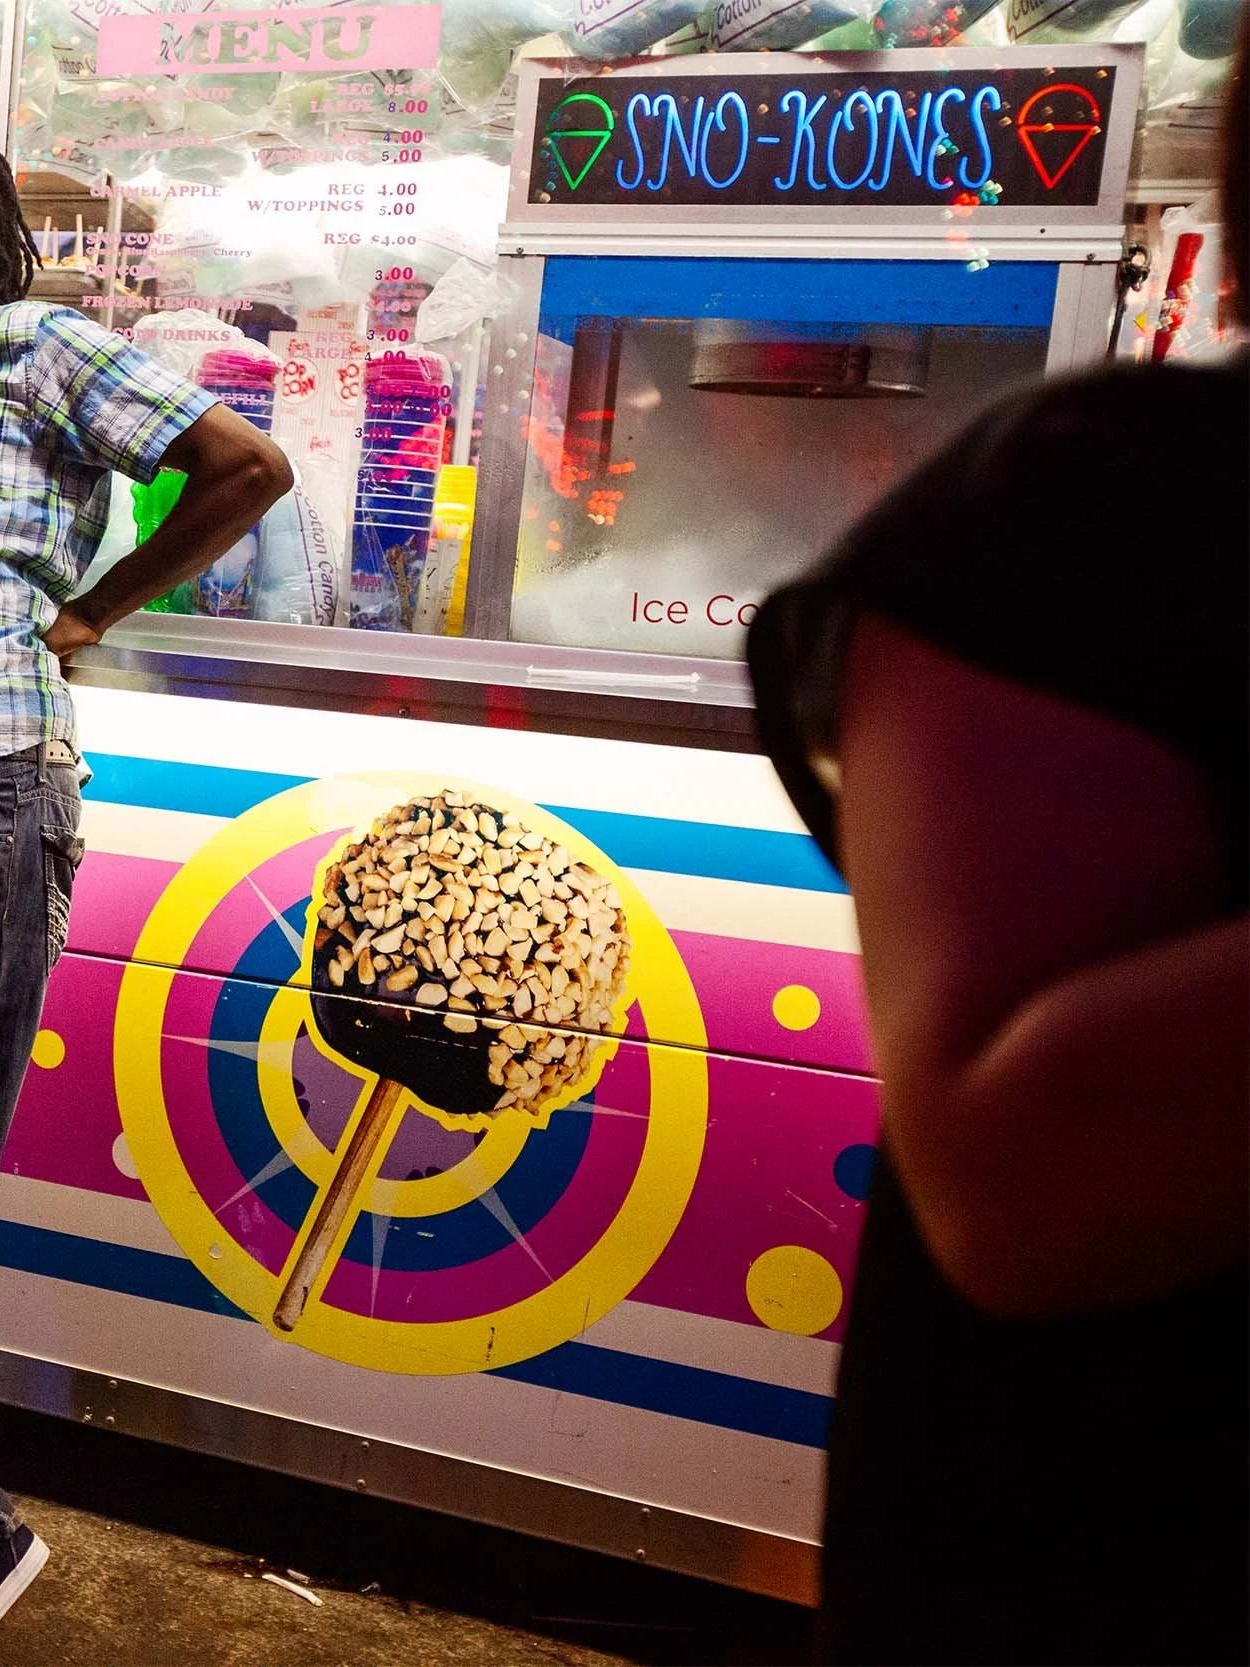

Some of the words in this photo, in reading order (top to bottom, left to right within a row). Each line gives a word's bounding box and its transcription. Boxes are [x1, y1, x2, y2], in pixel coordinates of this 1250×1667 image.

[155, 15, 376, 66] MENU
[388, 100, 429, 114] 8.00
[382, 130, 424, 145] 4.00
[615, 85, 1001, 192] SNO-KONES
[381, 149, 423, 164] 5.00
[89, 185, 162, 198] CARMEL
[165, 185, 223, 198] APPLE
[328, 183, 366, 196] REG
[377, 183, 418, 197] 4.00
[247, 200, 364, 214] W/TOPPINGS
[378, 202, 415, 216] 5.00
[125, 232, 174, 246] CONE
[323, 232, 362, 245] REG
[213, 248, 252, 258] Cherry
[374, 266, 414, 281] 3.00
[81, 295, 152, 309] FROZEN
[154, 296, 253, 311] LEMONADE
[163, 328, 231, 342] DRINKS
[366, 328, 410, 343] 3.00
[318, 560, 336, 619] Candy
[632, 591, 688, 625] Ice
